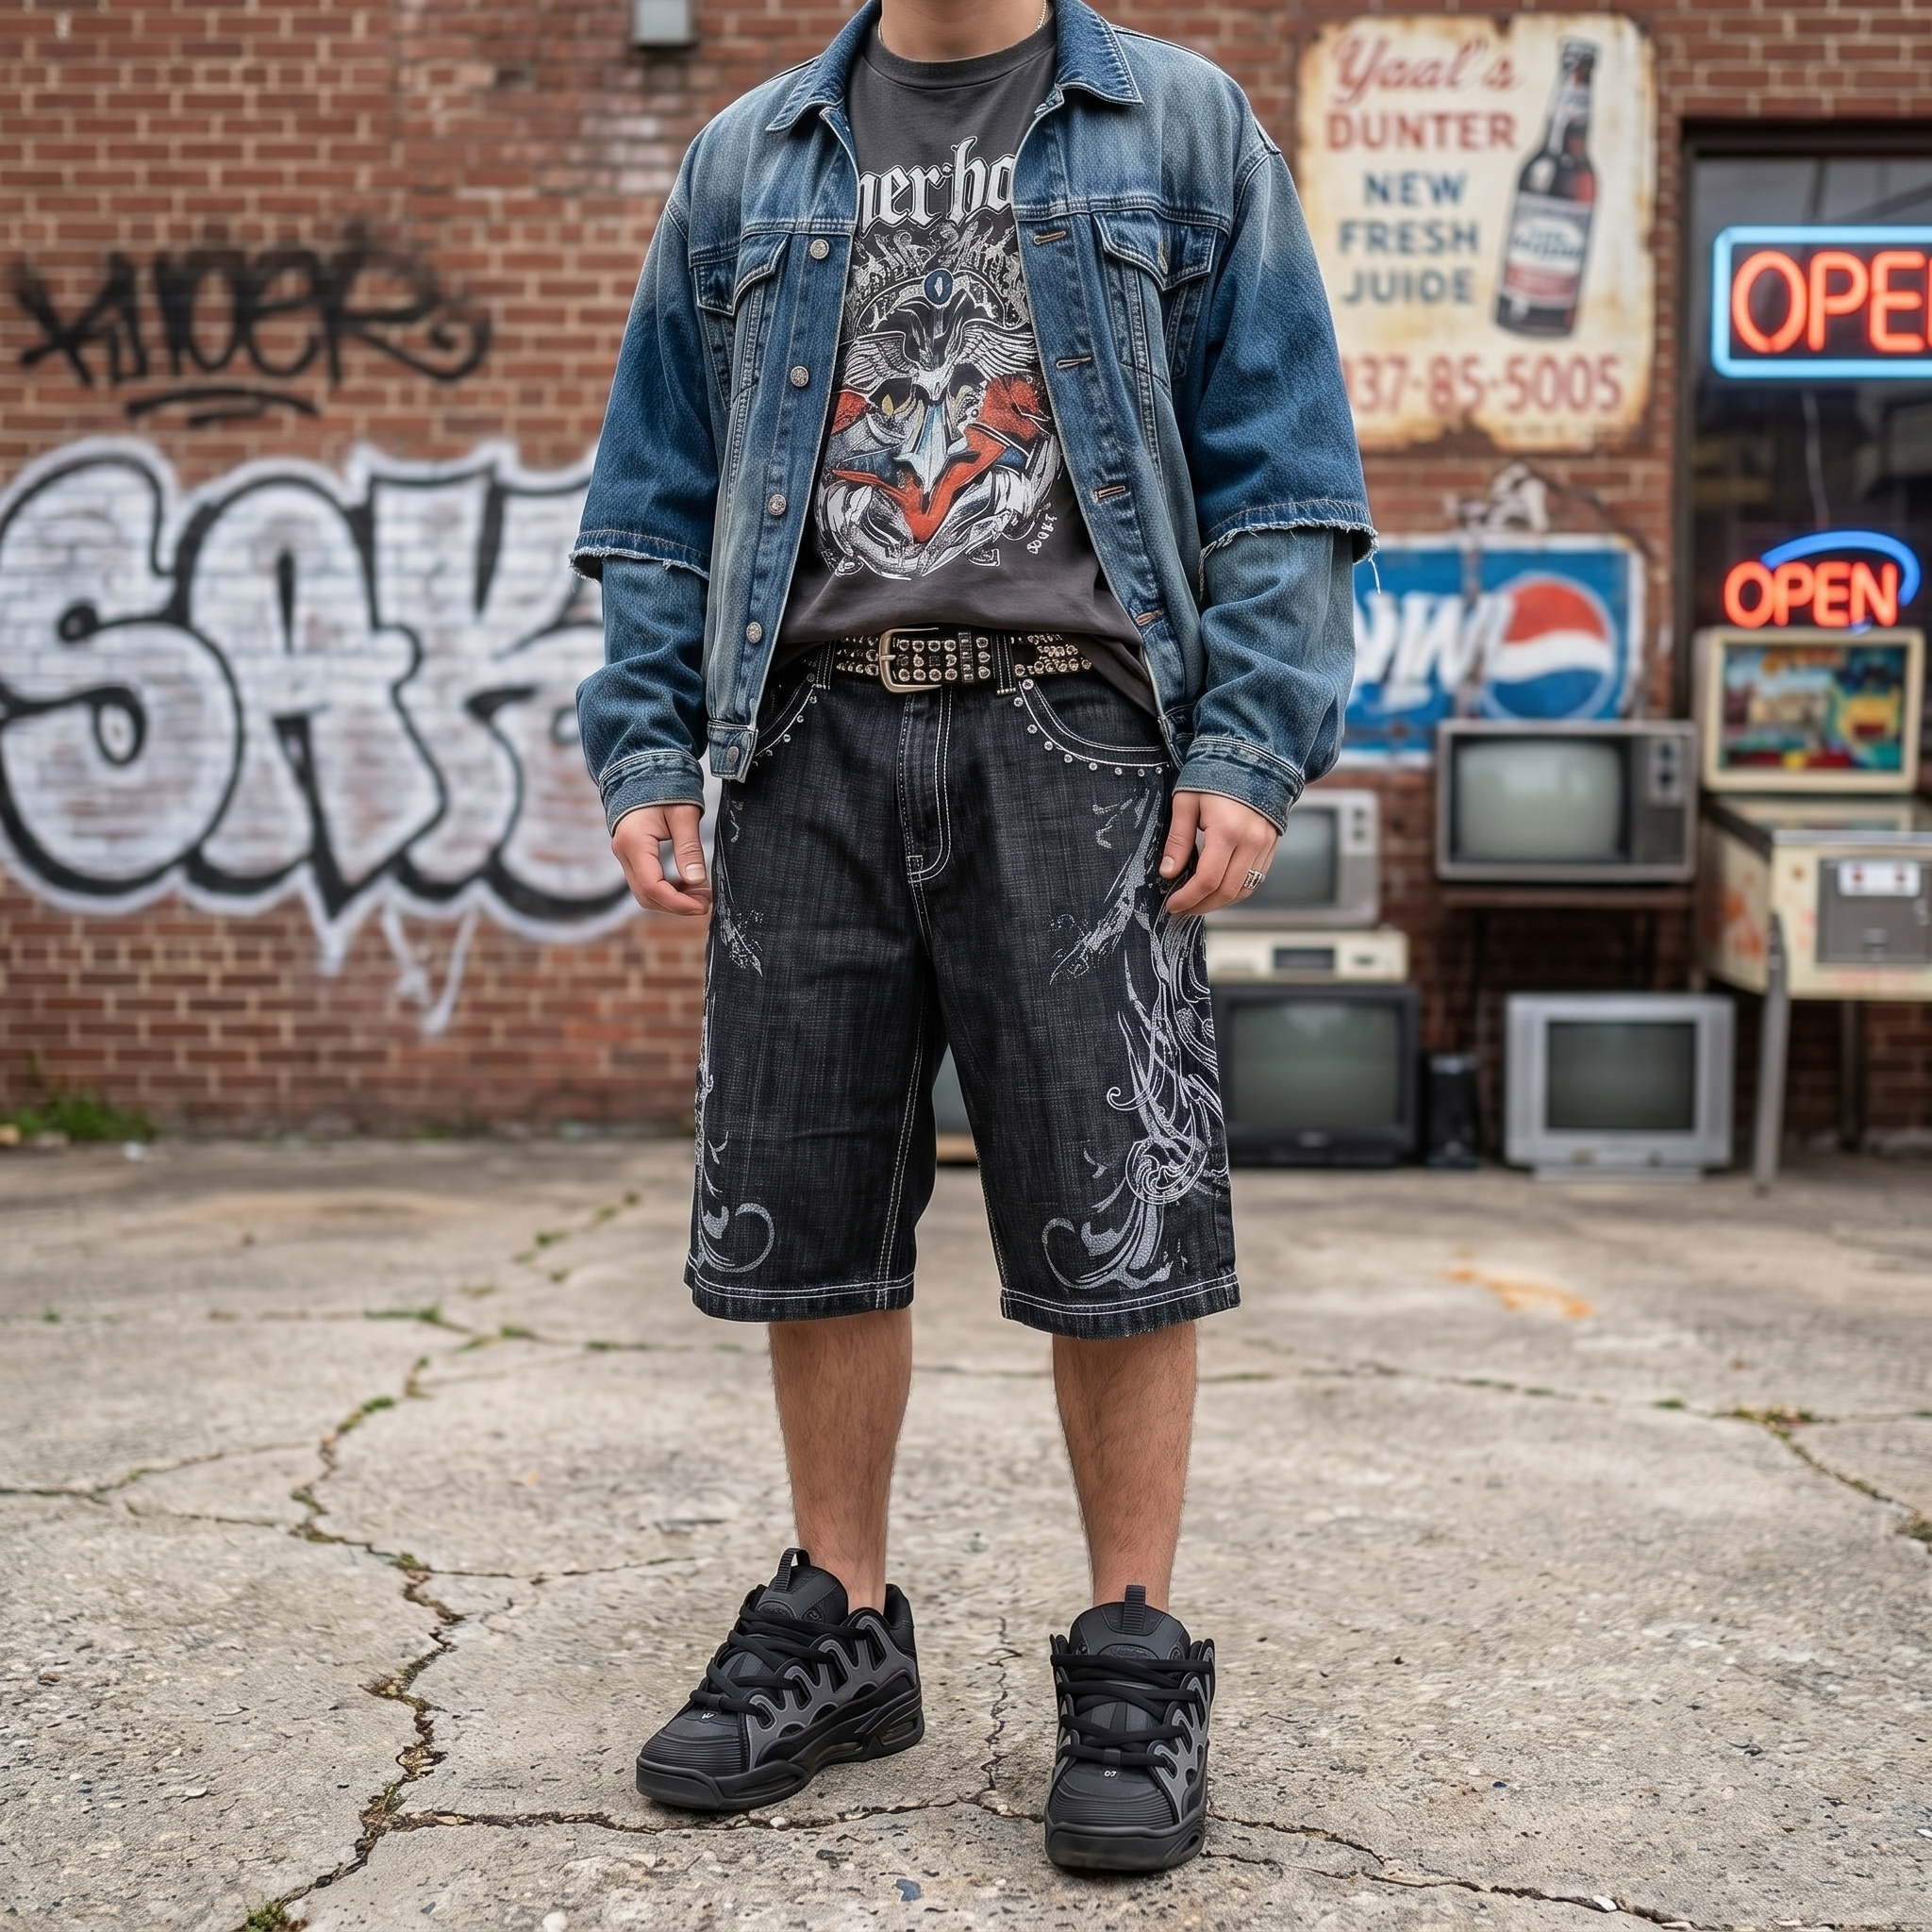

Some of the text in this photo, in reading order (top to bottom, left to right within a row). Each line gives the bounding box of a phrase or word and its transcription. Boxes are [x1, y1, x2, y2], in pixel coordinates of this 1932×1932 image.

[1326, 111, 1517, 151] DUNTER
[1364, 171, 1467, 208] NEW
[1339, 218, 1478, 255] FRESH
[1730, 250, 1932, 354] OPE
[1724, 560, 1899, 629] OPEN
